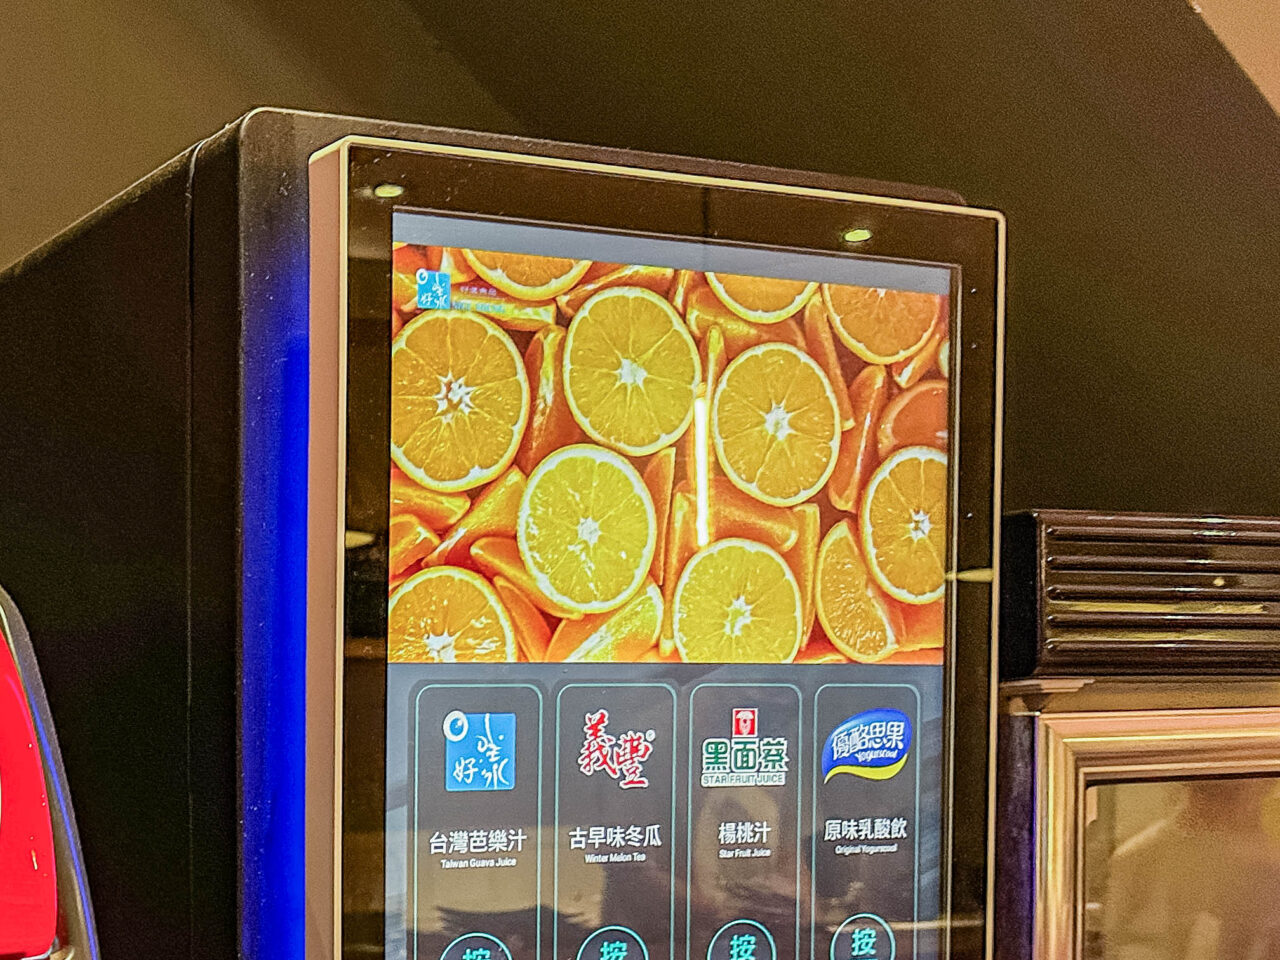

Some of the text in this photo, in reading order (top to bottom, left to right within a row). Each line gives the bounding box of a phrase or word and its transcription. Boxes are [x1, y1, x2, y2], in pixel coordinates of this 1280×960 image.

[702, 738, 790, 773] 黑面蔡
[703, 774, 783, 785] STAR FRUIT JUICE
[569, 824, 662, 850] 古早味冬瓜
[718, 821, 771, 845] 楊桃汁
[824, 817, 907, 841] 原味乳酸飲
[429, 829, 527, 854] 台灣芭樂汁
[719, 848, 771, 858] Star Fruit Juice
[441, 857, 517, 869] Taiwan Guava Juice
[584, 852, 646, 864] Winter Melon Tea
[851, 928, 877, 956] 按
